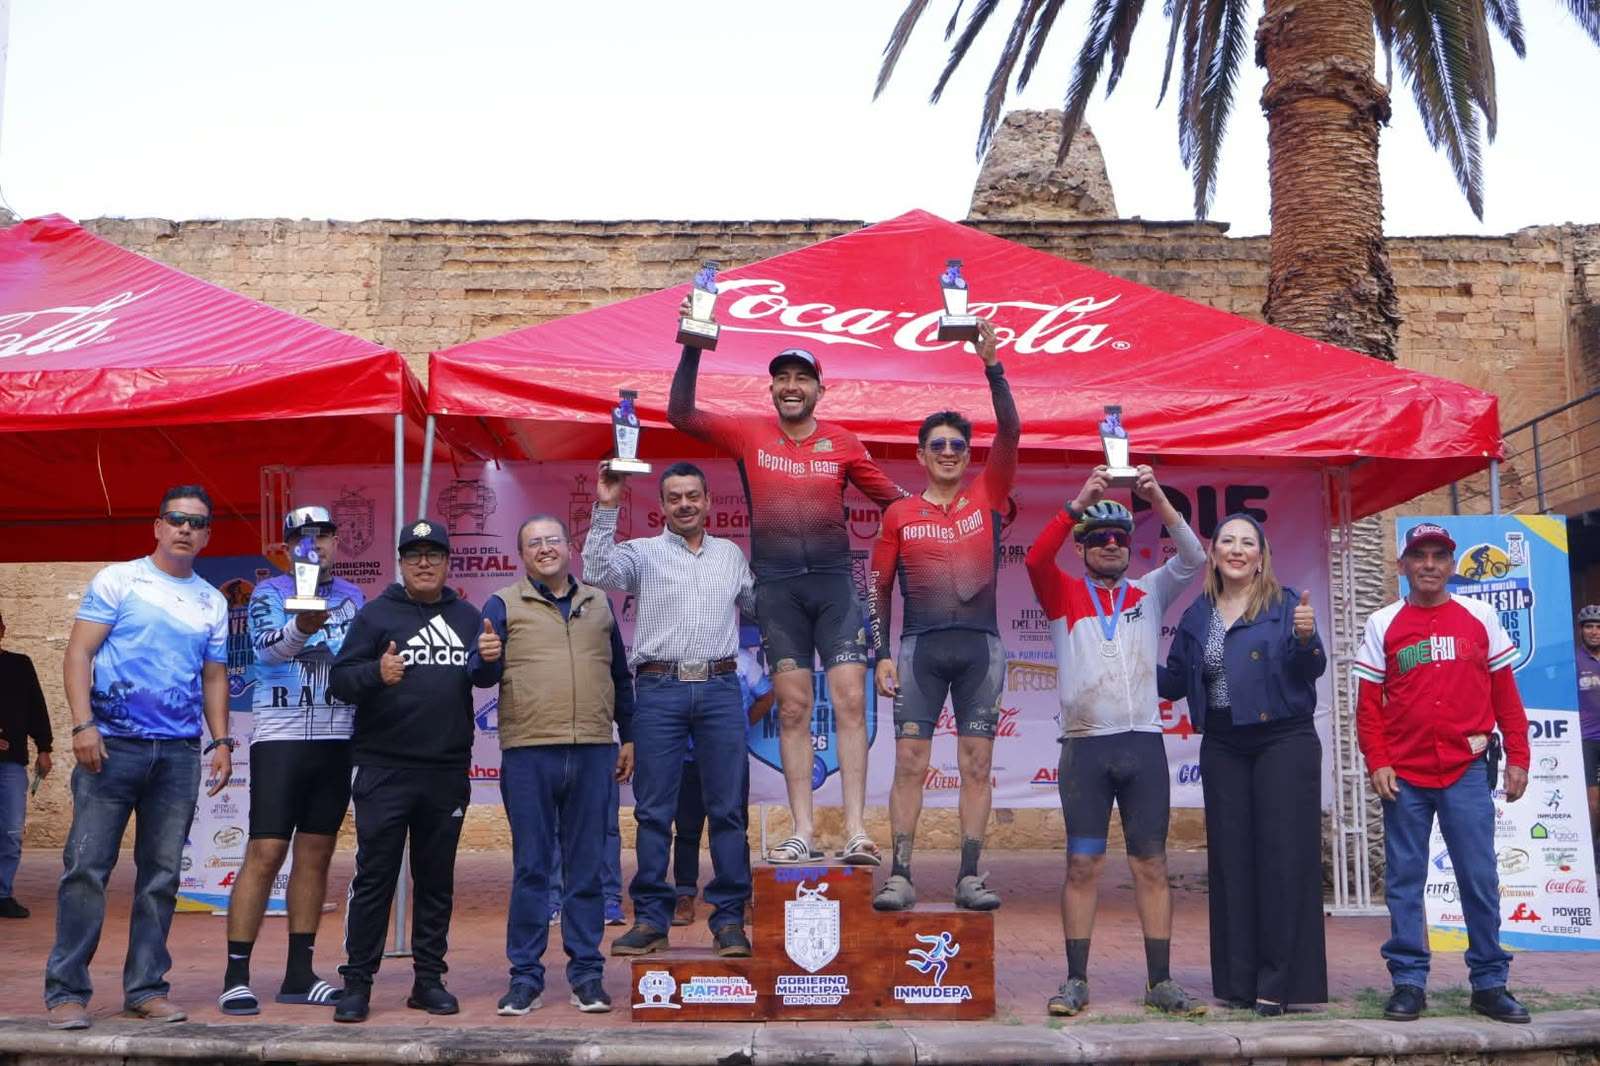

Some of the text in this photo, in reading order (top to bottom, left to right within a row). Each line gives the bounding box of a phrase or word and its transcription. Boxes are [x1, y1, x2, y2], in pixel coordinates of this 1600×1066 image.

[715, 278, 1122, 356] Coca-Cola
[757, 449, 839, 475] Reptiles Team
[903, 509, 983, 541] Reptiles Team
[450, 556, 517, 571] RRAL
[1552, 907, 1591, 917] POWER
[1571, 916, 1592, 926] ADE
[778, 976, 846, 985] GOBIERNO
[683, 984, 755, 996] PARRAL
[776, 985, 849, 994] MUNICIPAL
[894, 988, 970, 999] INMUDEPA
